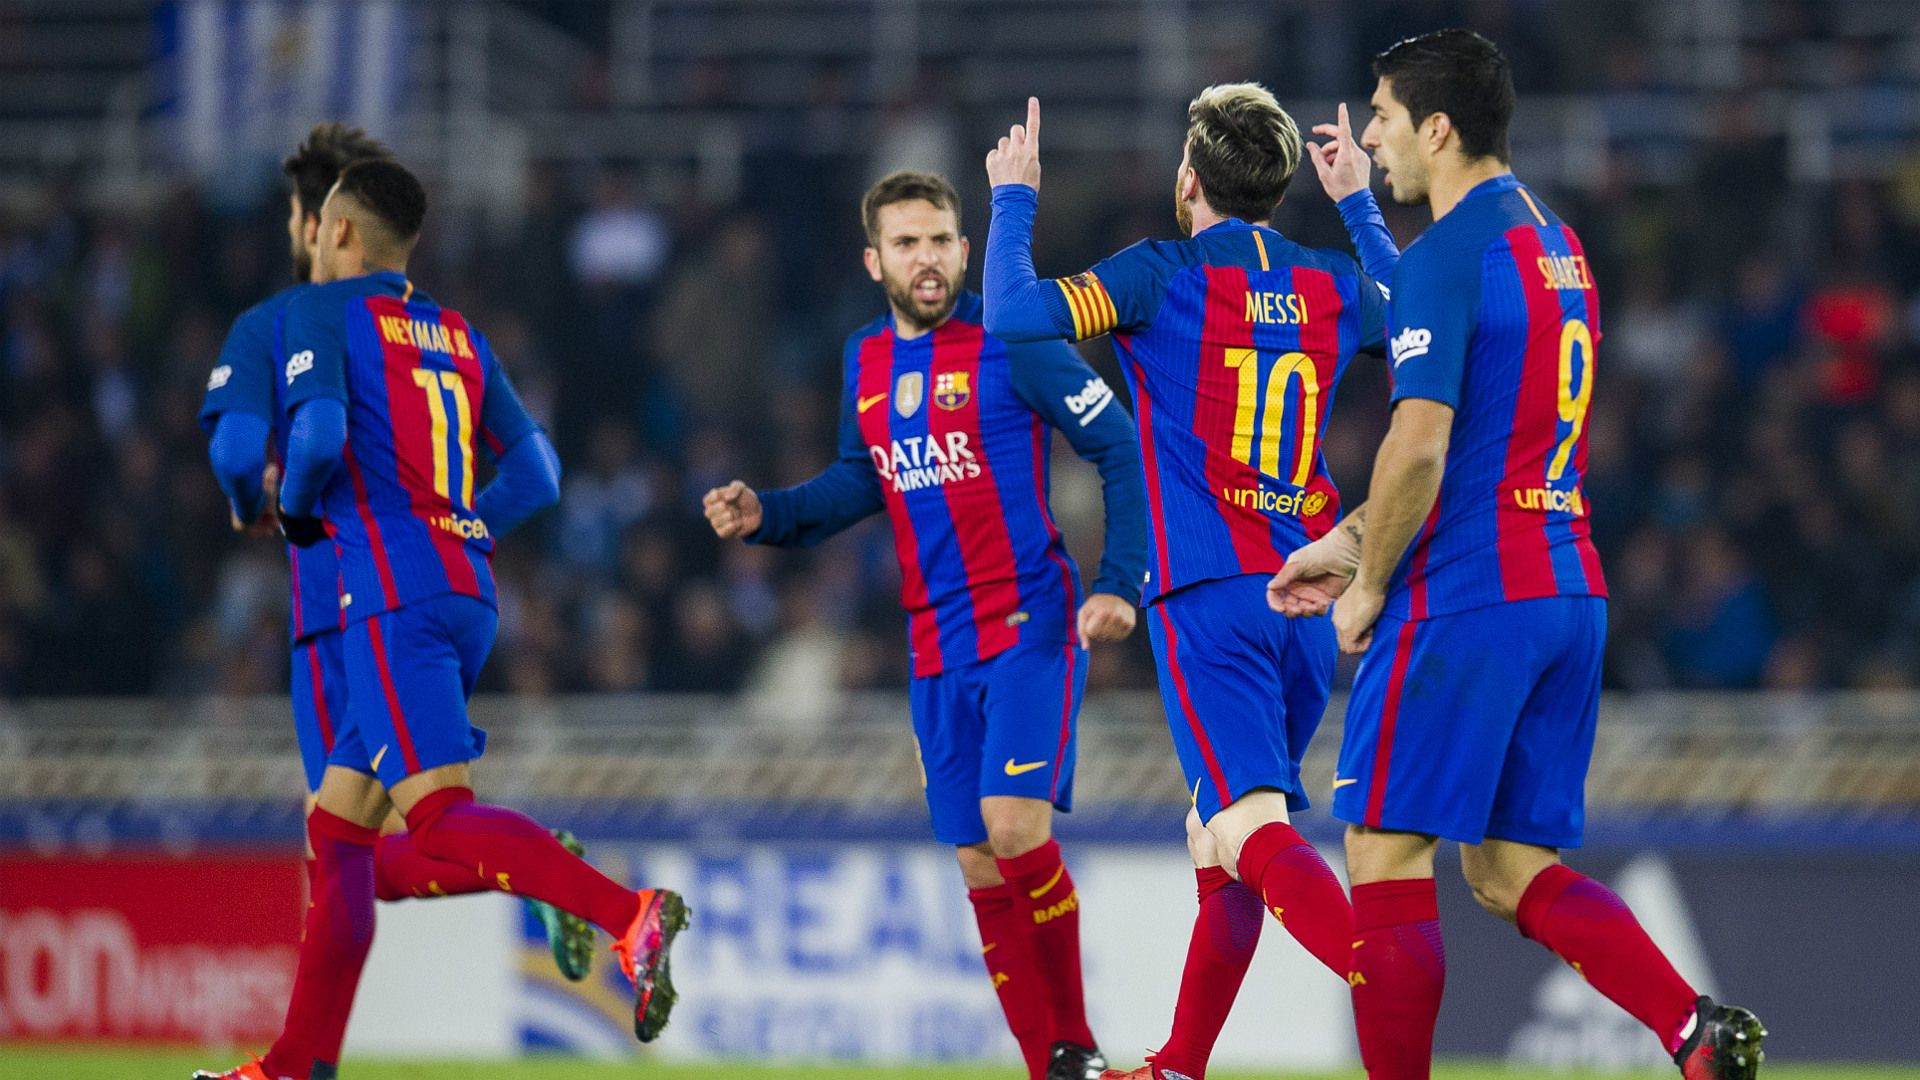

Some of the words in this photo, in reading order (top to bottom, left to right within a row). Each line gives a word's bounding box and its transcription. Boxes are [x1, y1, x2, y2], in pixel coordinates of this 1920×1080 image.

[1537, 250, 1592, 290] SUÁREZ
[1244, 290, 1309, 324] MESSI
[379, 314, 455, 355] NEYMAR
[1223, 346, 1320, 488] 10
[1546, 318, 1594, 481] 9
[411, 367, 475, 512] 11
[869, 430, 976, 481] QATAR
[893, 461, 982, 493] AIRWAYS
[1222, 483, 1306, 516] unicef
[692, 850, 992, 975] REAL
